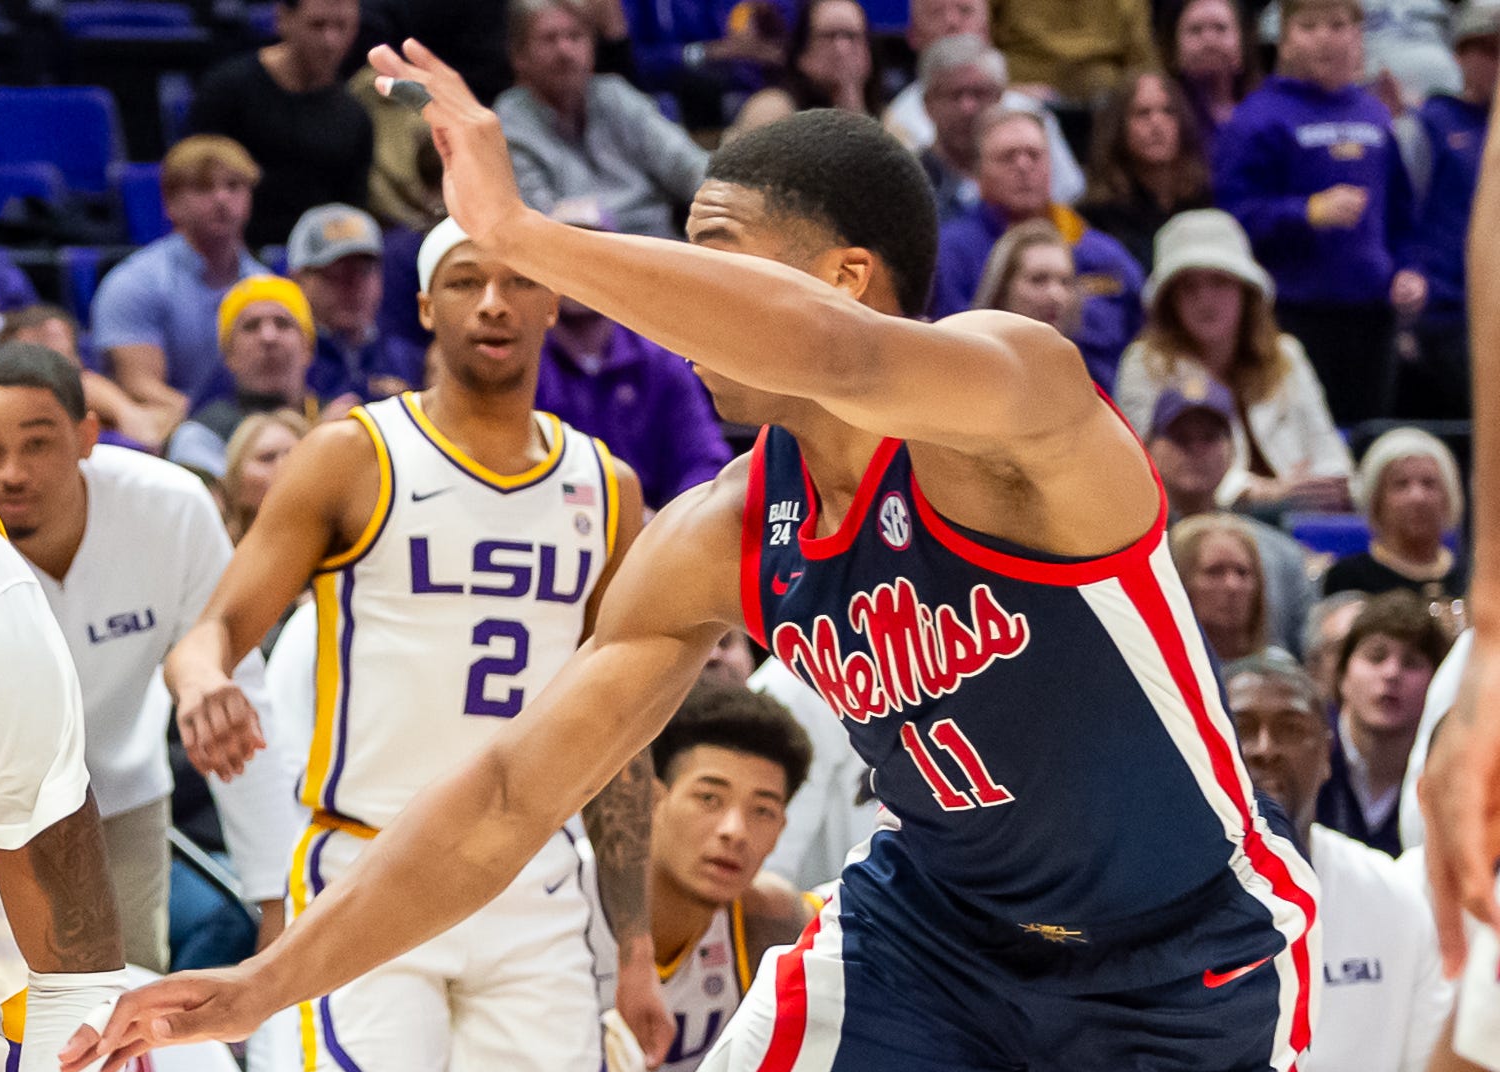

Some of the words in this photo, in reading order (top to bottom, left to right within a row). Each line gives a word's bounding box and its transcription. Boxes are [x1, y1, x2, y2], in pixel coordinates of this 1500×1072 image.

[768, 501, 800, 523] BALL
[769, 522, 791, 545] 24
[409, 536, 592, 604] LSU
[86, 608, 156, 645] LSU
[772, 614, 888, 724] Ole
[849, 577, 1031, 712] Miss
[463, 618, 530, 719] 2
[900, 718, 1015, 812] 11
[1322, 957, 1383, 986] LSU
